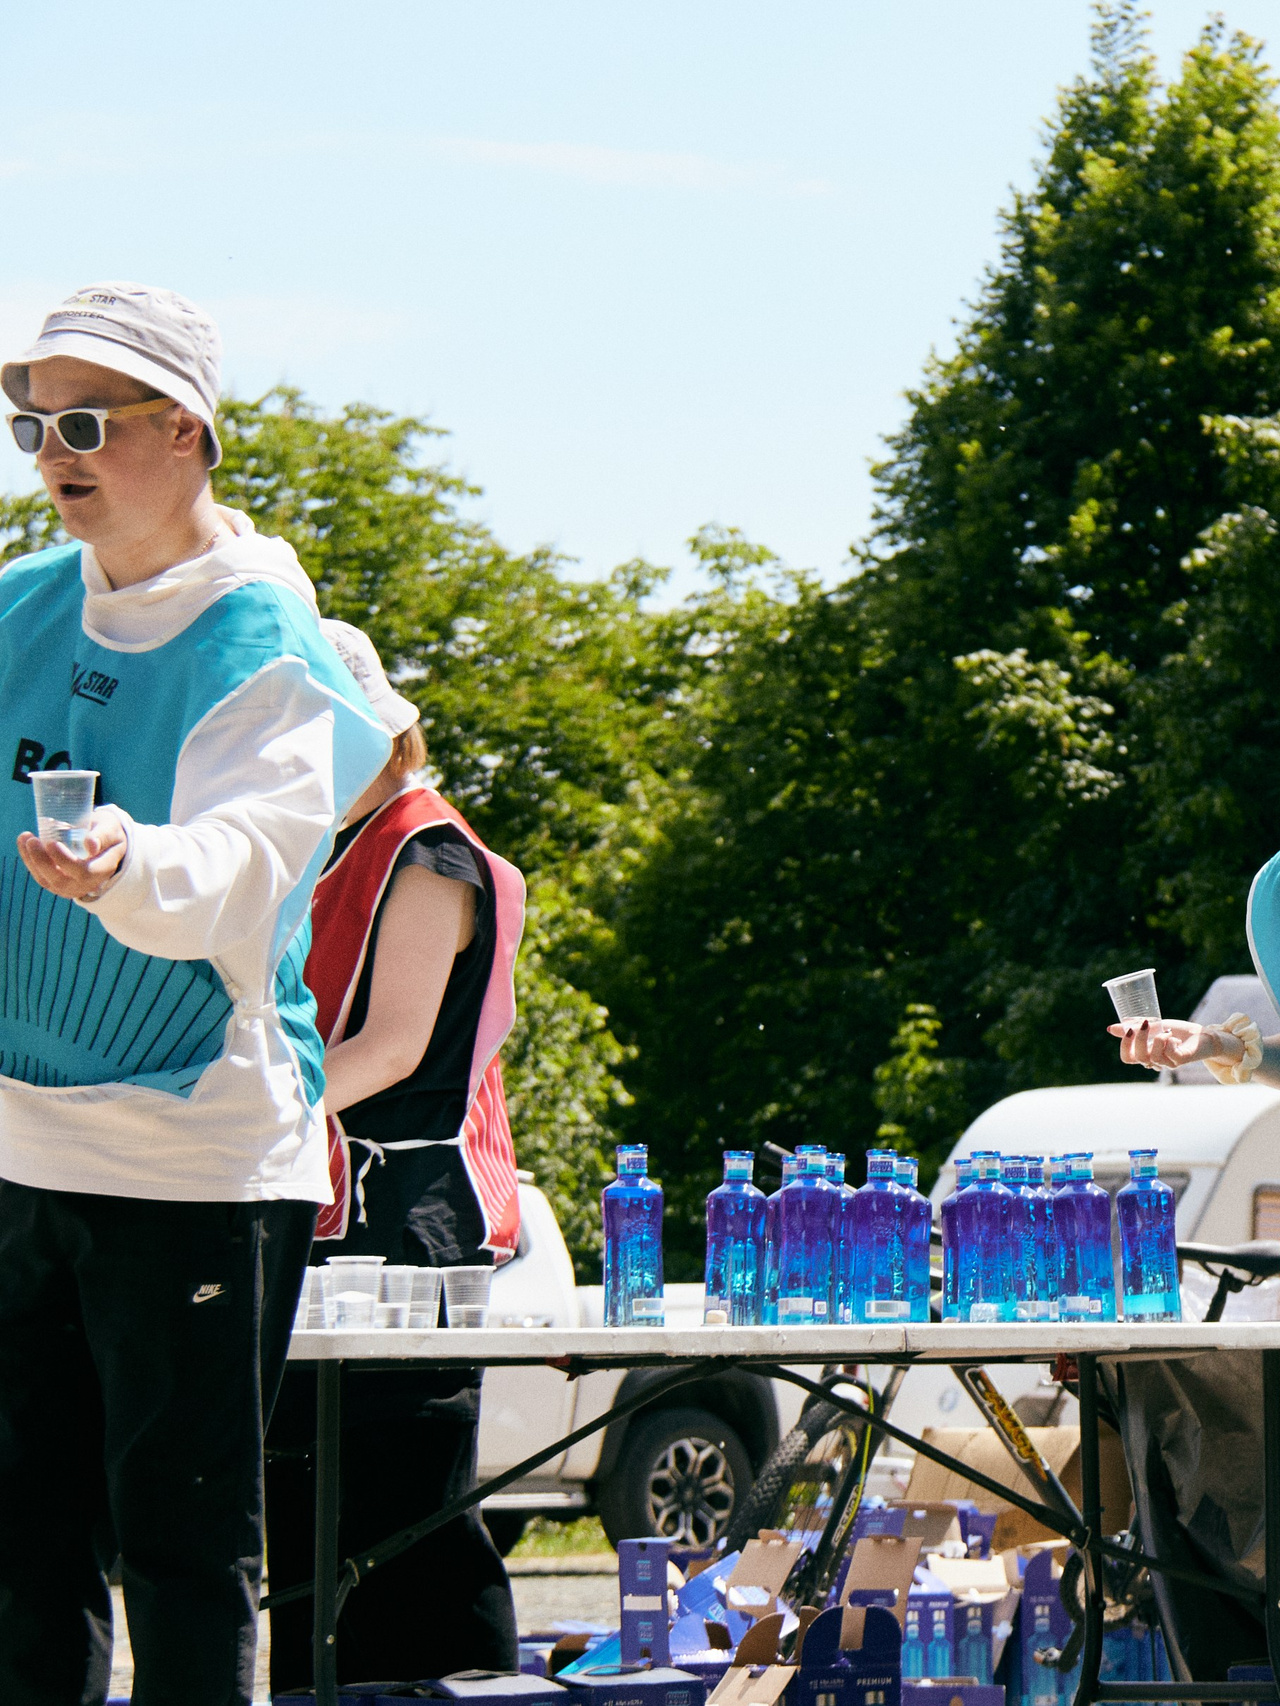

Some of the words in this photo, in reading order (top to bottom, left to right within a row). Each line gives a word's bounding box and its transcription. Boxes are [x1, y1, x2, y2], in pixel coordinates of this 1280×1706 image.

[89, 294, 117, 306] STAR
[83, 670, 119, 699] STAR
[199, 1284, 222, 1294] NIKE
[856, 1677, 893, 1687] PREMIUM
